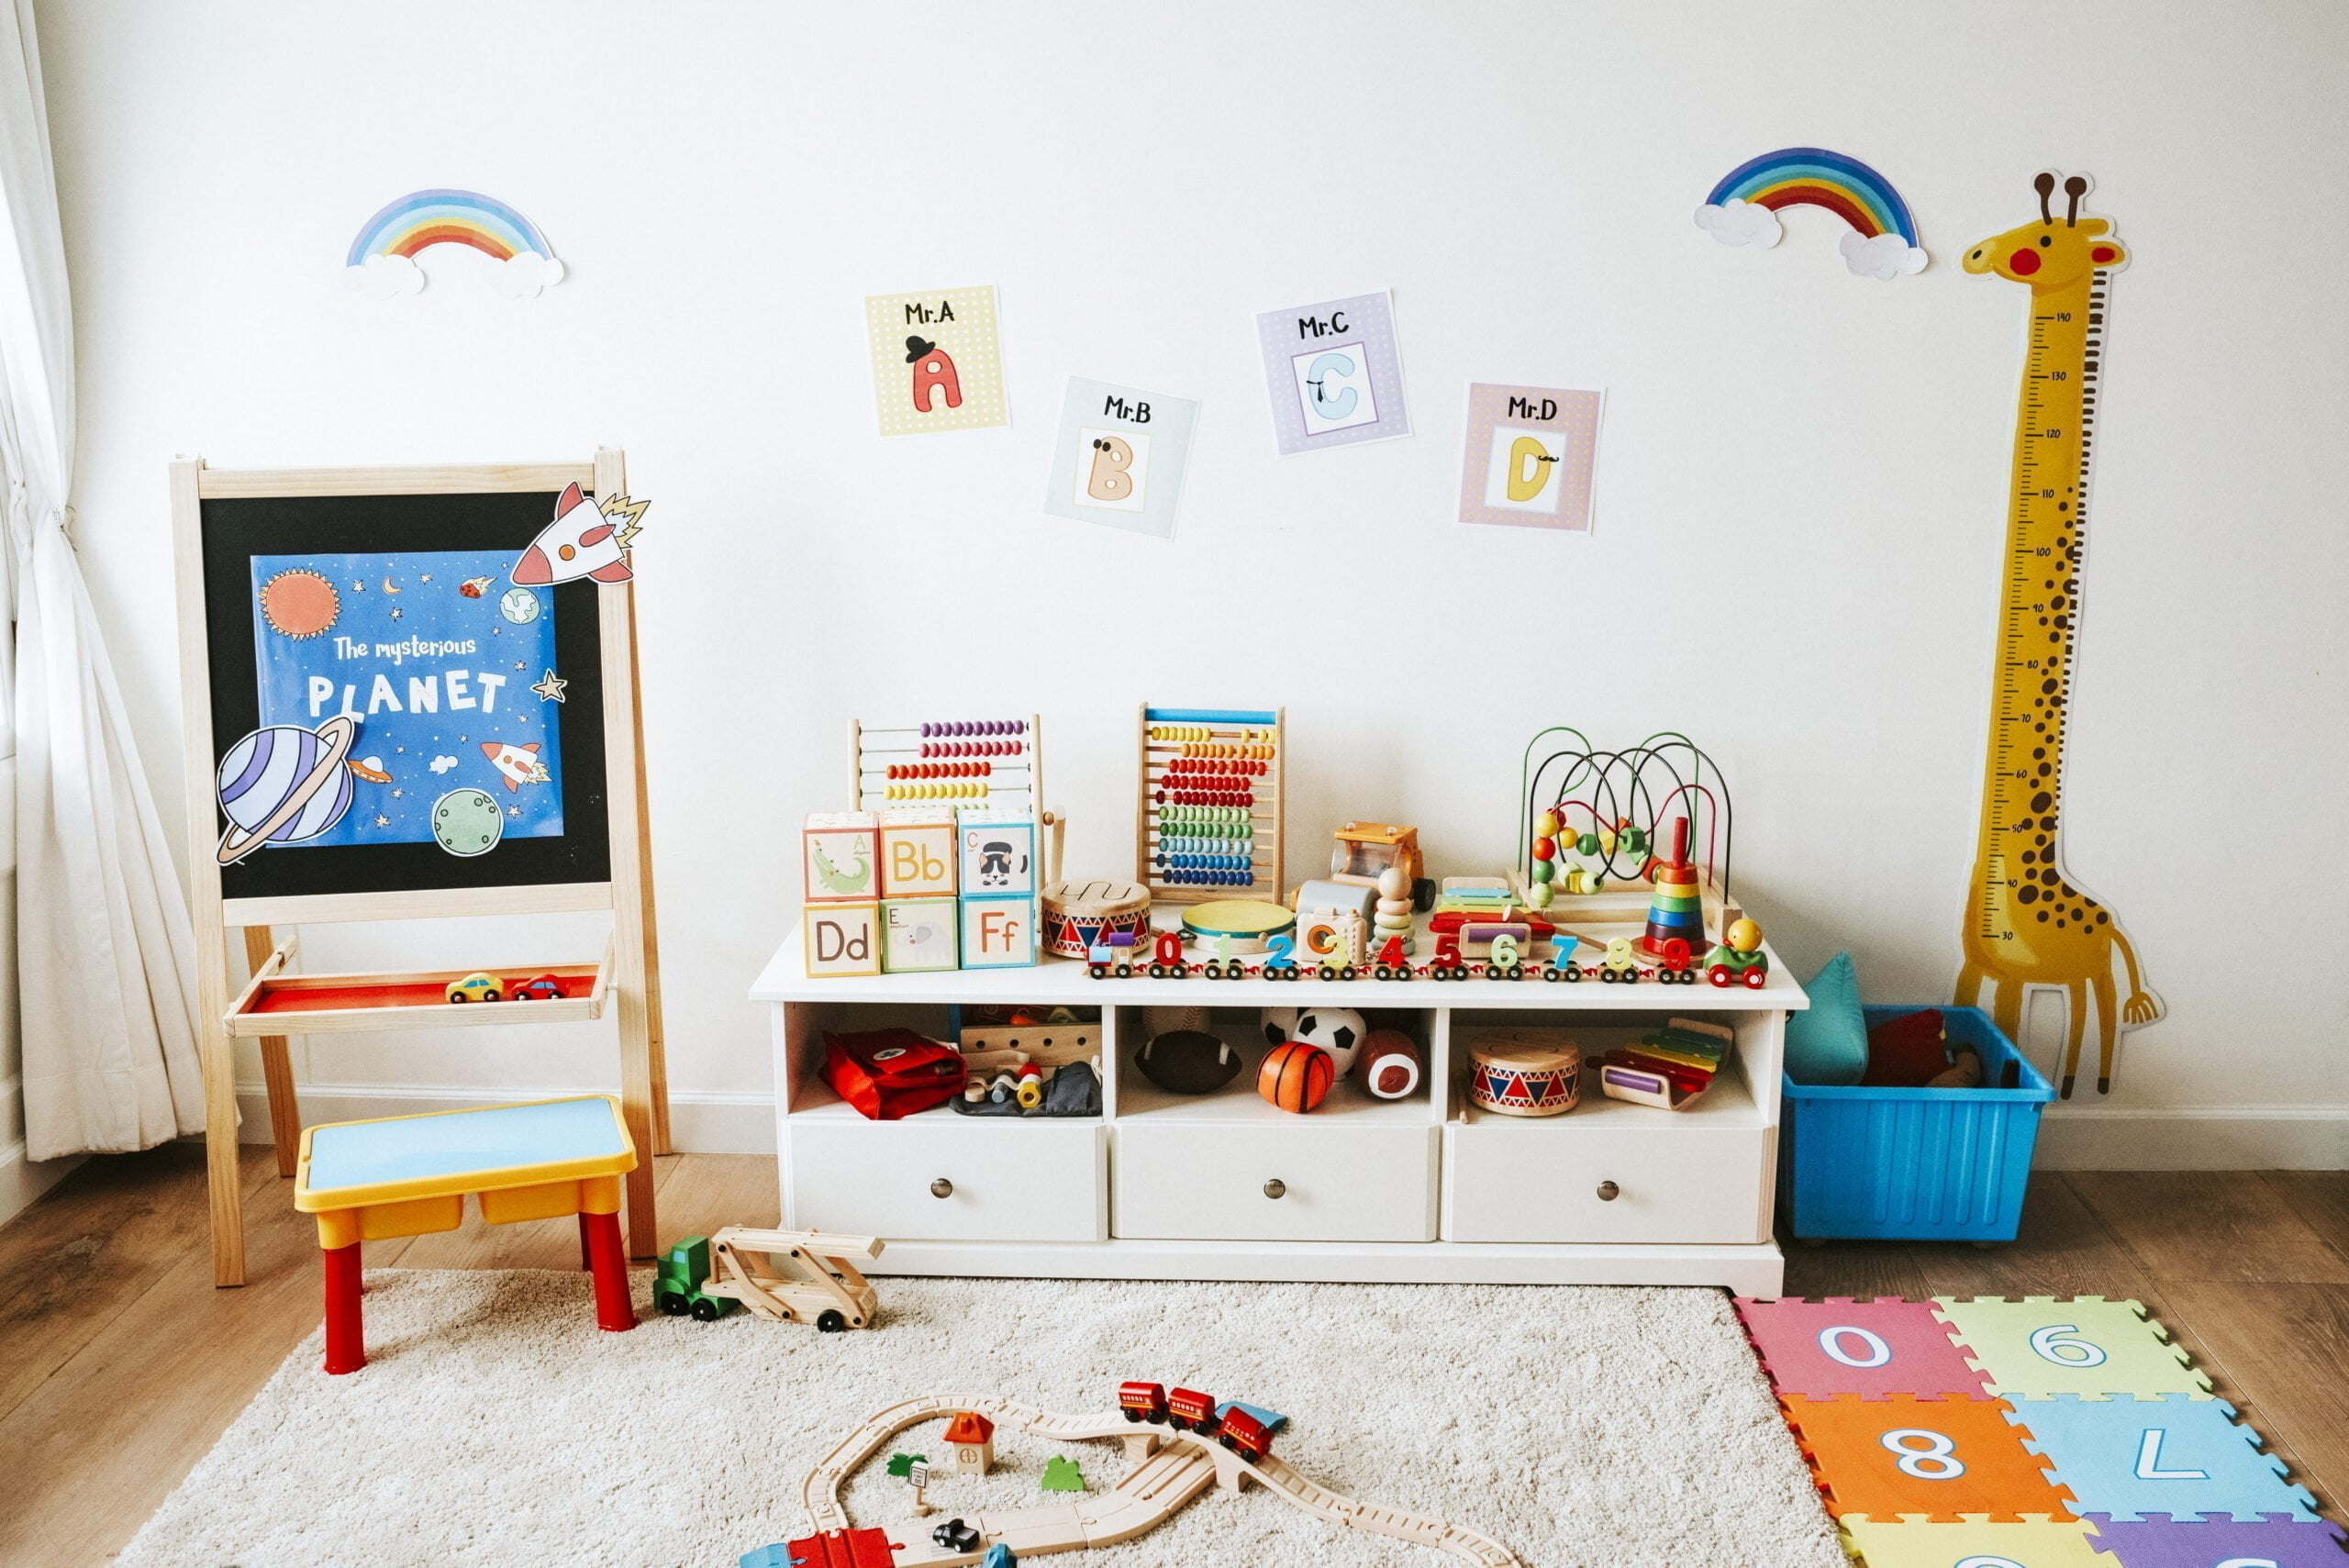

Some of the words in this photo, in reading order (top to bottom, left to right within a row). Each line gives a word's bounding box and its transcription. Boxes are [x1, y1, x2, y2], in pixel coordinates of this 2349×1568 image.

[905, 300, 955, 325] Mr.A
[1297, 311, 1350, 339] Mr.C
[2056, 313, 2071, 322] 140
[913, 348, 963, 413] A
[1308, 352, 1358, 420] C
[2052, 372, 2066, 381] 130
[1104, 395, 1152, 424] Mr.B
[1508, 395, 1557, 421] Mr.D
[2046, 428, 2061, 439] 120
[1087, 436, 1133, 501] B
[1507, 436, 1551, 502] D
[2042, 489, 2054, 498] 110
[2036, 547, 2051, 557] 100
[2032, 604, 2044, 613] 90
[333, 636, 369, 661] The
[375, 635, 476, 665] mysterious
[2027, 660, 2039, 669] 80
[308, 670, 507, 723] PLANET
[2021, 714, 2032, 724] 70
[2016, 770, 2027, 779] 60
[967, 832, 978, 848] C
[2011, 824, 2023, 833] 50
[853, 834, 866, 851] A
[892, 840, 945, 882] Bb
[2007, 879, 2018, 888] 40
[889, 908, 899, 925] E
[816, 920, 869, 962] Dd
[980, 911, 1019, 953] Ff
[2002, 931, 2013, 940] 30
[1155, 932, 1183, 966] 0
[1212, 933, 1231, 969] 1
[1266, 934, 1294, 968] 2
[1323, 935, 1351, 969] 3
[1377, 935, 1407, 969] 4
[1434, 934, 1462, 968] 5
[1490, 933, 1520, 967] 6
[1550, 935, 1579, 970] 7
[1606, 937, 1633, 971] 8
[1663, 937, 1691, 971] 9
[1817, 1325, 1893, 1368] 0
[1879, 1428, 1966, 1481] 8
